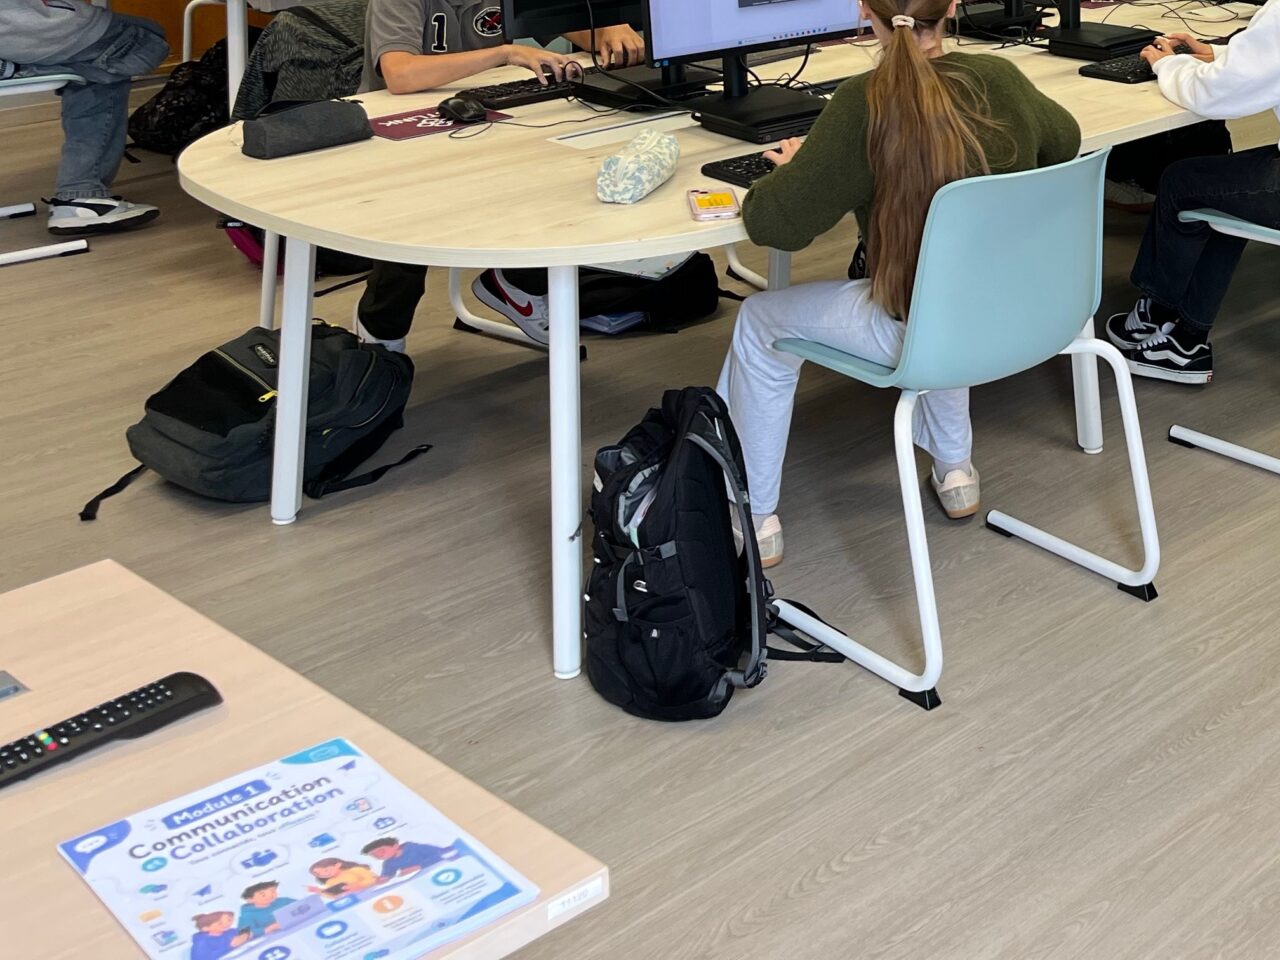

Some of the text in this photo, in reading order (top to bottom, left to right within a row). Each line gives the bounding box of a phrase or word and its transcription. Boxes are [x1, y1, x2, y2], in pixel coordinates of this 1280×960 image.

[431, 13, 448, 52] 1
[378, 111, 440, 127] TLINK
[128, 776, 332, 859] Communication
[170, 786, 344, 860] Collaboration
[173, 785, 260, 825] Module 1
